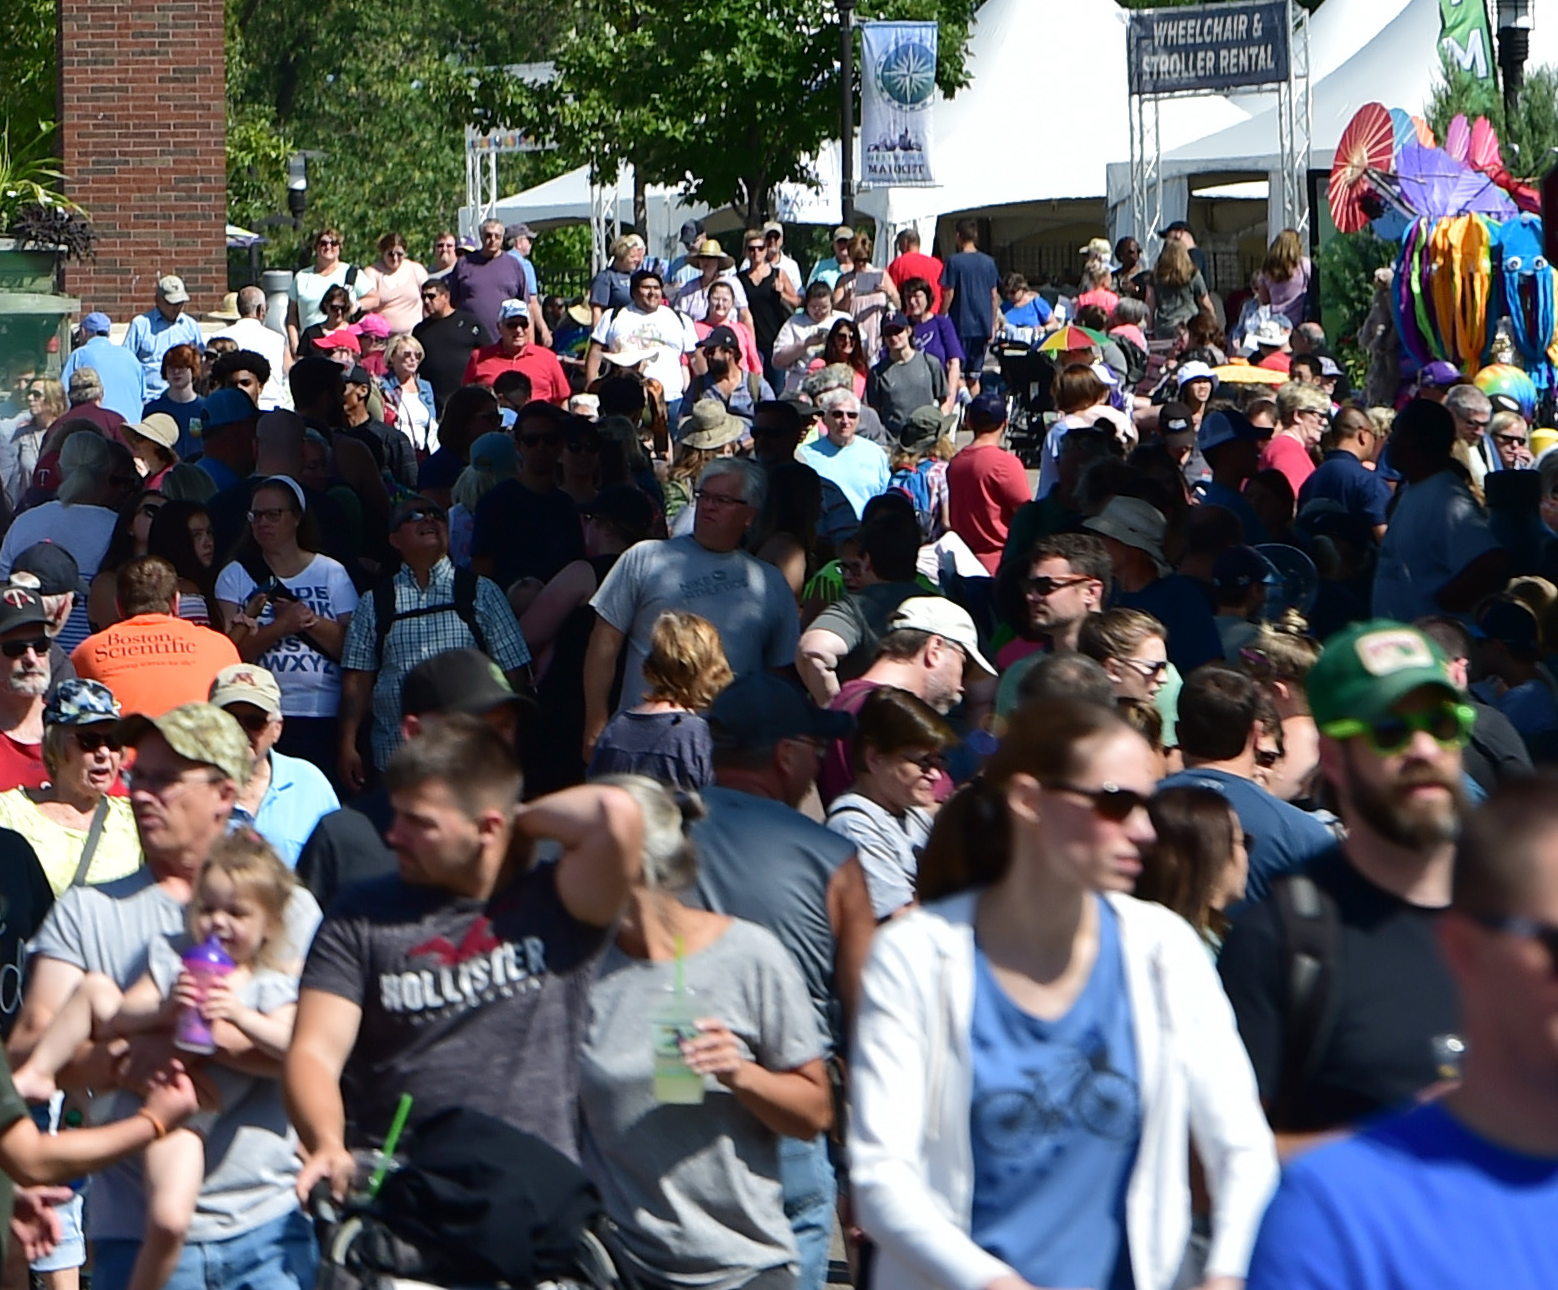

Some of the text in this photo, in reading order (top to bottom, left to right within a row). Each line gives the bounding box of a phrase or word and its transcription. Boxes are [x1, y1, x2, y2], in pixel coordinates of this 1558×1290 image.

[1152, 12, 1263, 48] WHEELCHAIR &
[1141, 43, 1276, 81] STROLLER RENTAL
[94, 636, 197, 663] Scientific
[107, 633, 172, 646] Boston
[380, 936, 547, 1011] HOLLISTER
